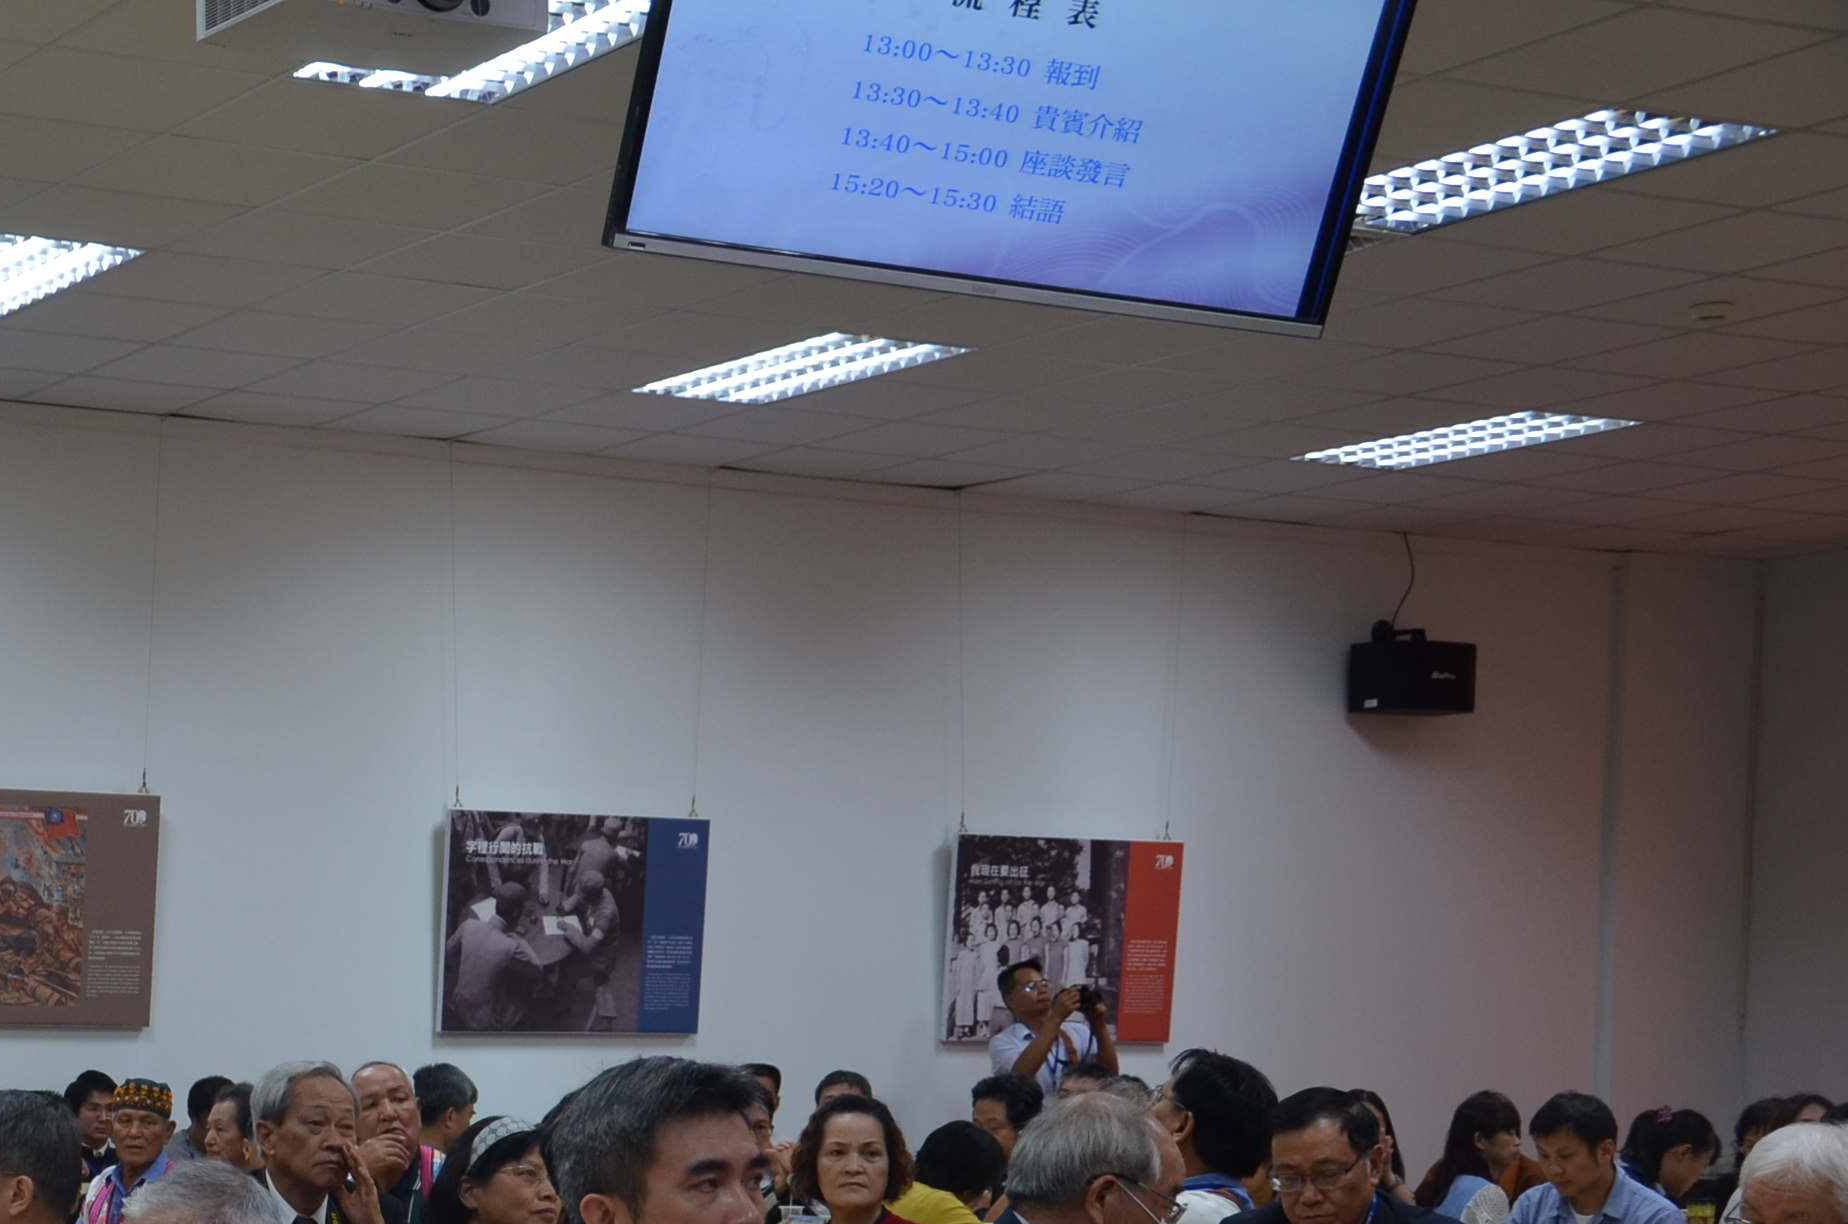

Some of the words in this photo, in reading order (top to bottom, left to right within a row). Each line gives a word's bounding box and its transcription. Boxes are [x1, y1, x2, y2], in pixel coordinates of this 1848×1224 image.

[1044, 58, 1102, 91] 報到
[1032, 104, 1144, 144] 貴賓介紹
[1019, 150, 1132, 188] 座談發言
[1008, 193, 1067, 225] 結語
